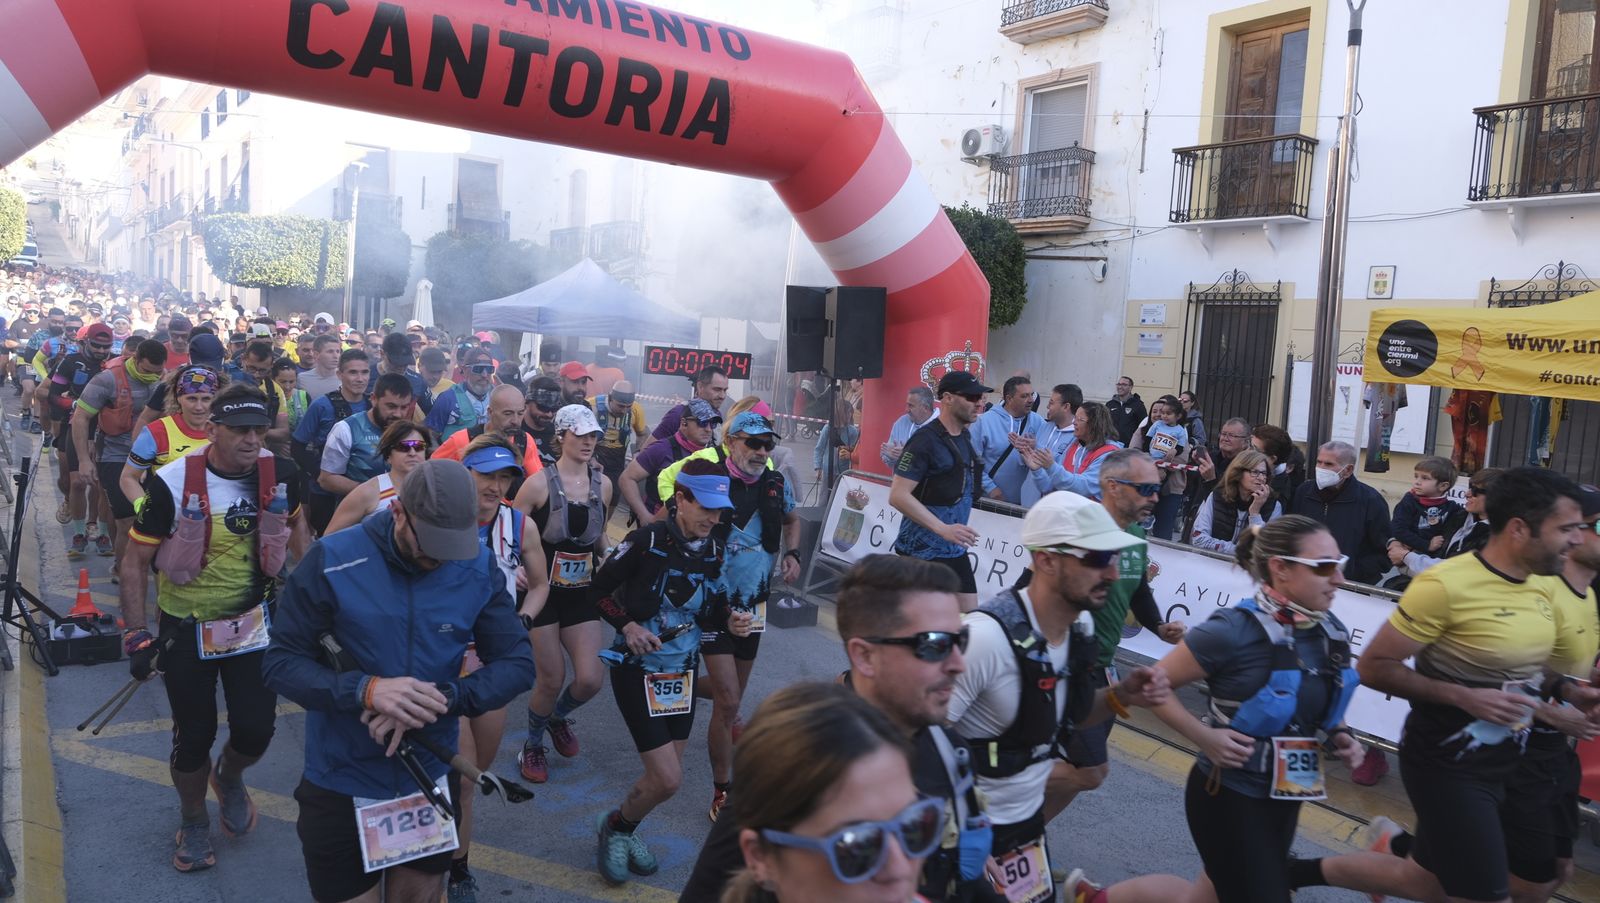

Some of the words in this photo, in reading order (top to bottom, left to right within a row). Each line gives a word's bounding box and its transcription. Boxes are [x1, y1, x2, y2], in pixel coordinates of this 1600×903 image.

[286, 0, 731, 146] CANTORIA
[1388, 345, 1412, 353] entre
[1389, 338, 1406, 346] uno
[653, 680, 683, 696] 356
[378, 806, 435, 836] 128
[1005, 856, 1030, 885] 50
